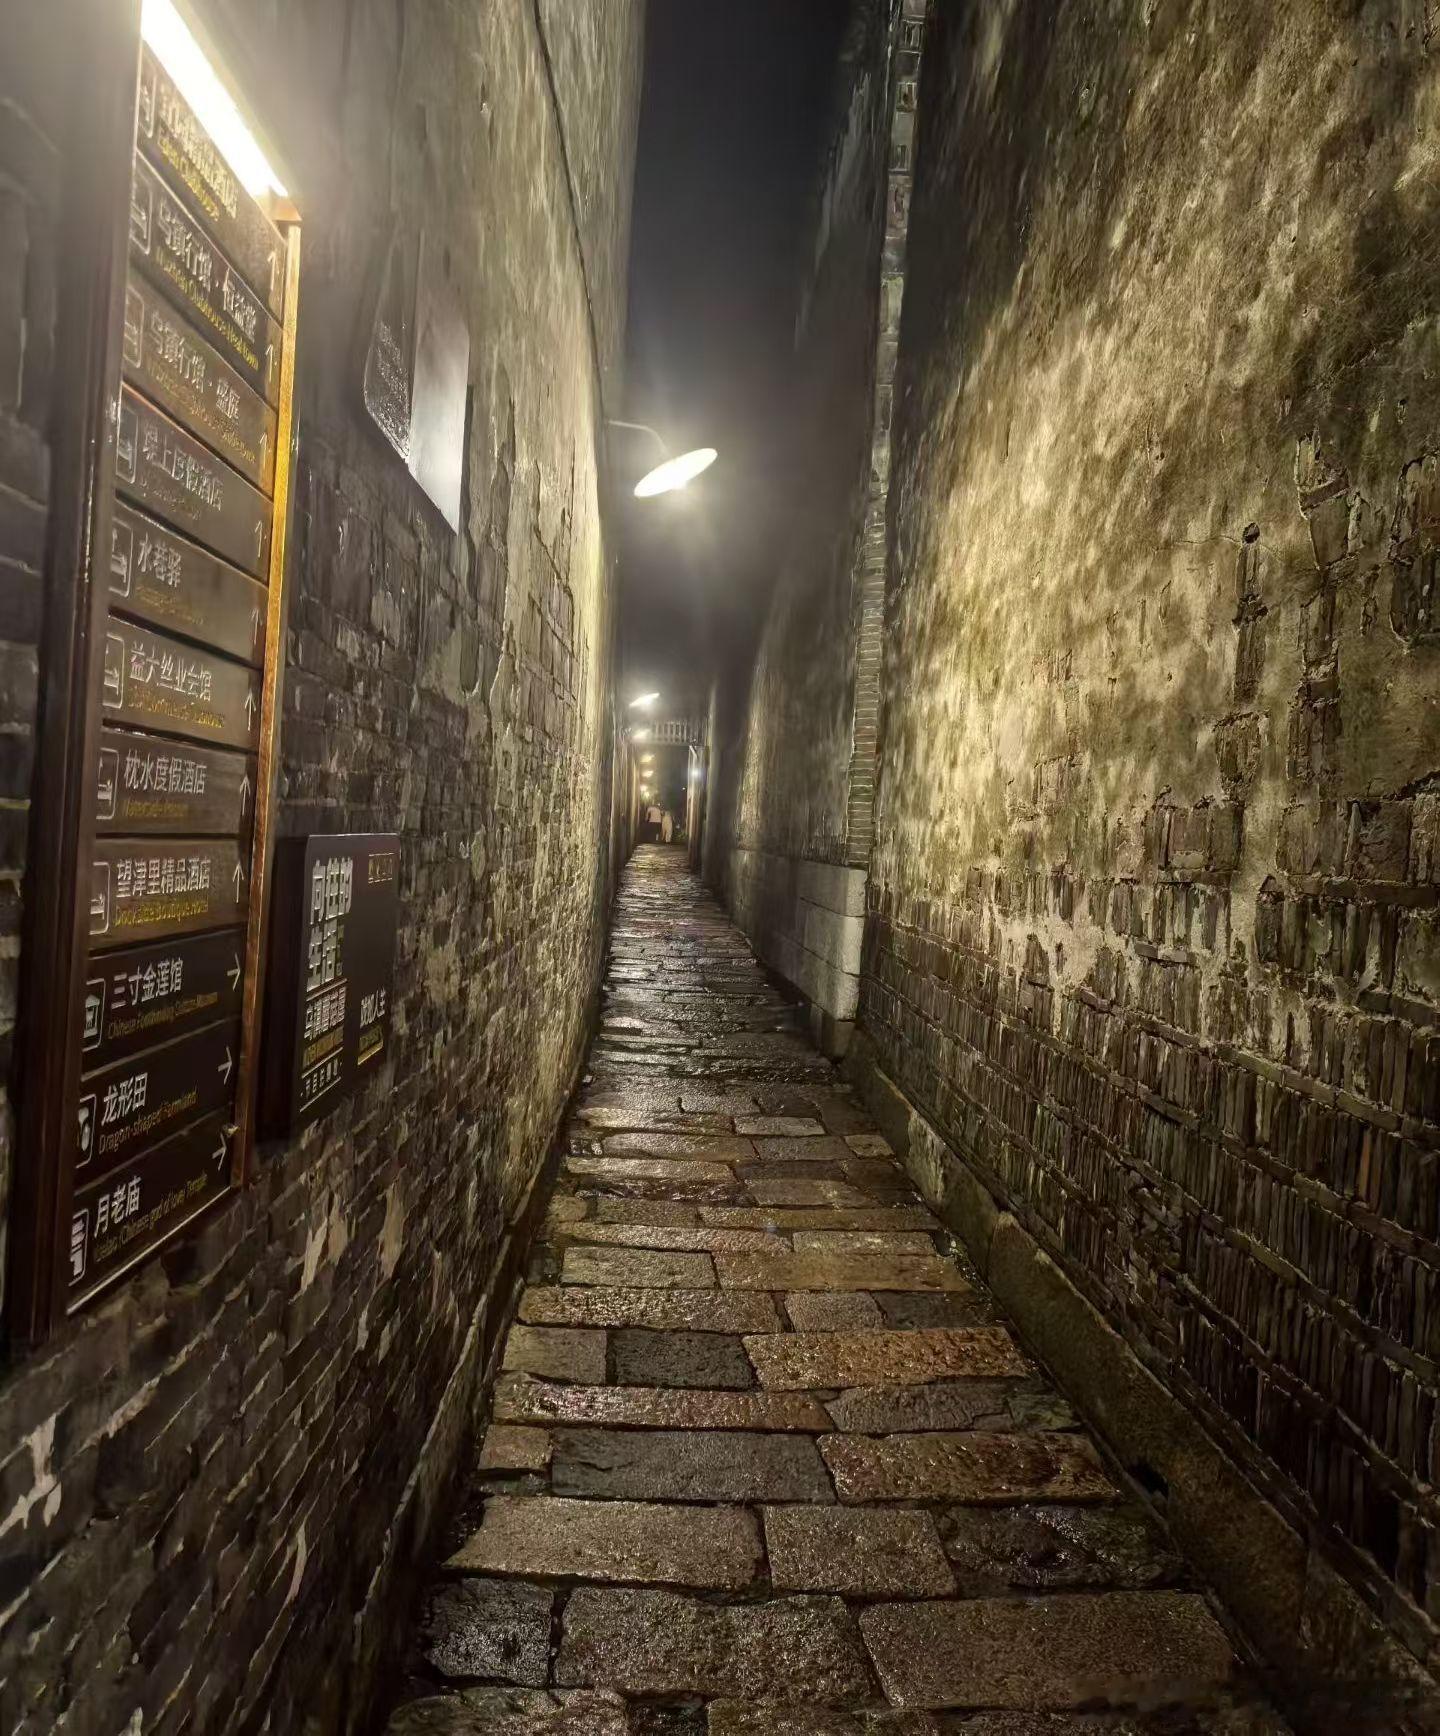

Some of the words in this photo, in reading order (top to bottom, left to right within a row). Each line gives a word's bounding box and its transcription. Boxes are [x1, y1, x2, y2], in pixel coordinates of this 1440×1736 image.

[129, 640, 212, 702] 益大丝业会馆
[123, 749, 207, 794] 枕水度假酒店
[116, 857, 211, 898] 望津里精品酒店
[111, 957, 184, 1009] 三寸金莲馆
[101, 1072, 148, 1126] 龙形田
[94, 1176, 141, 1238] 月老庙
